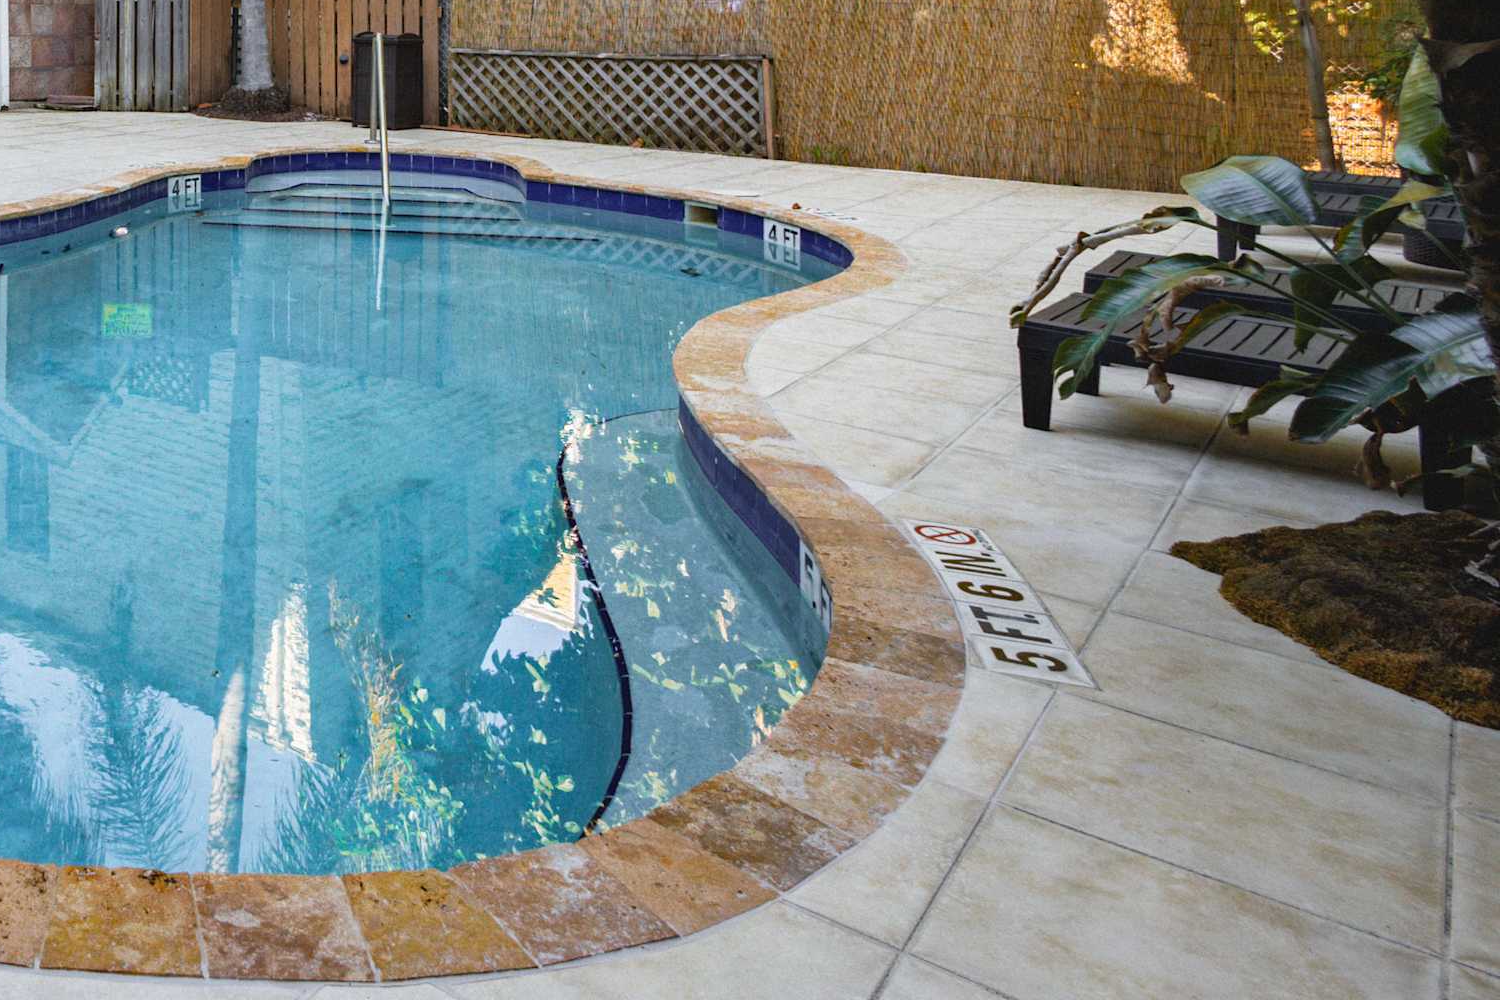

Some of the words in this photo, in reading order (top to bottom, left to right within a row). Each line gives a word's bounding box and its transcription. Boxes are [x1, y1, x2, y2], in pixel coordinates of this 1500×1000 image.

[172, 179, 180, 195] 4
[184, 177, 200, 195] FT
[768, 224, 777, 242] 4
[783, 228, 798, 248] FT
[956, 580, 1024, 602] 6
[990, 646, 1068, 673] 5
